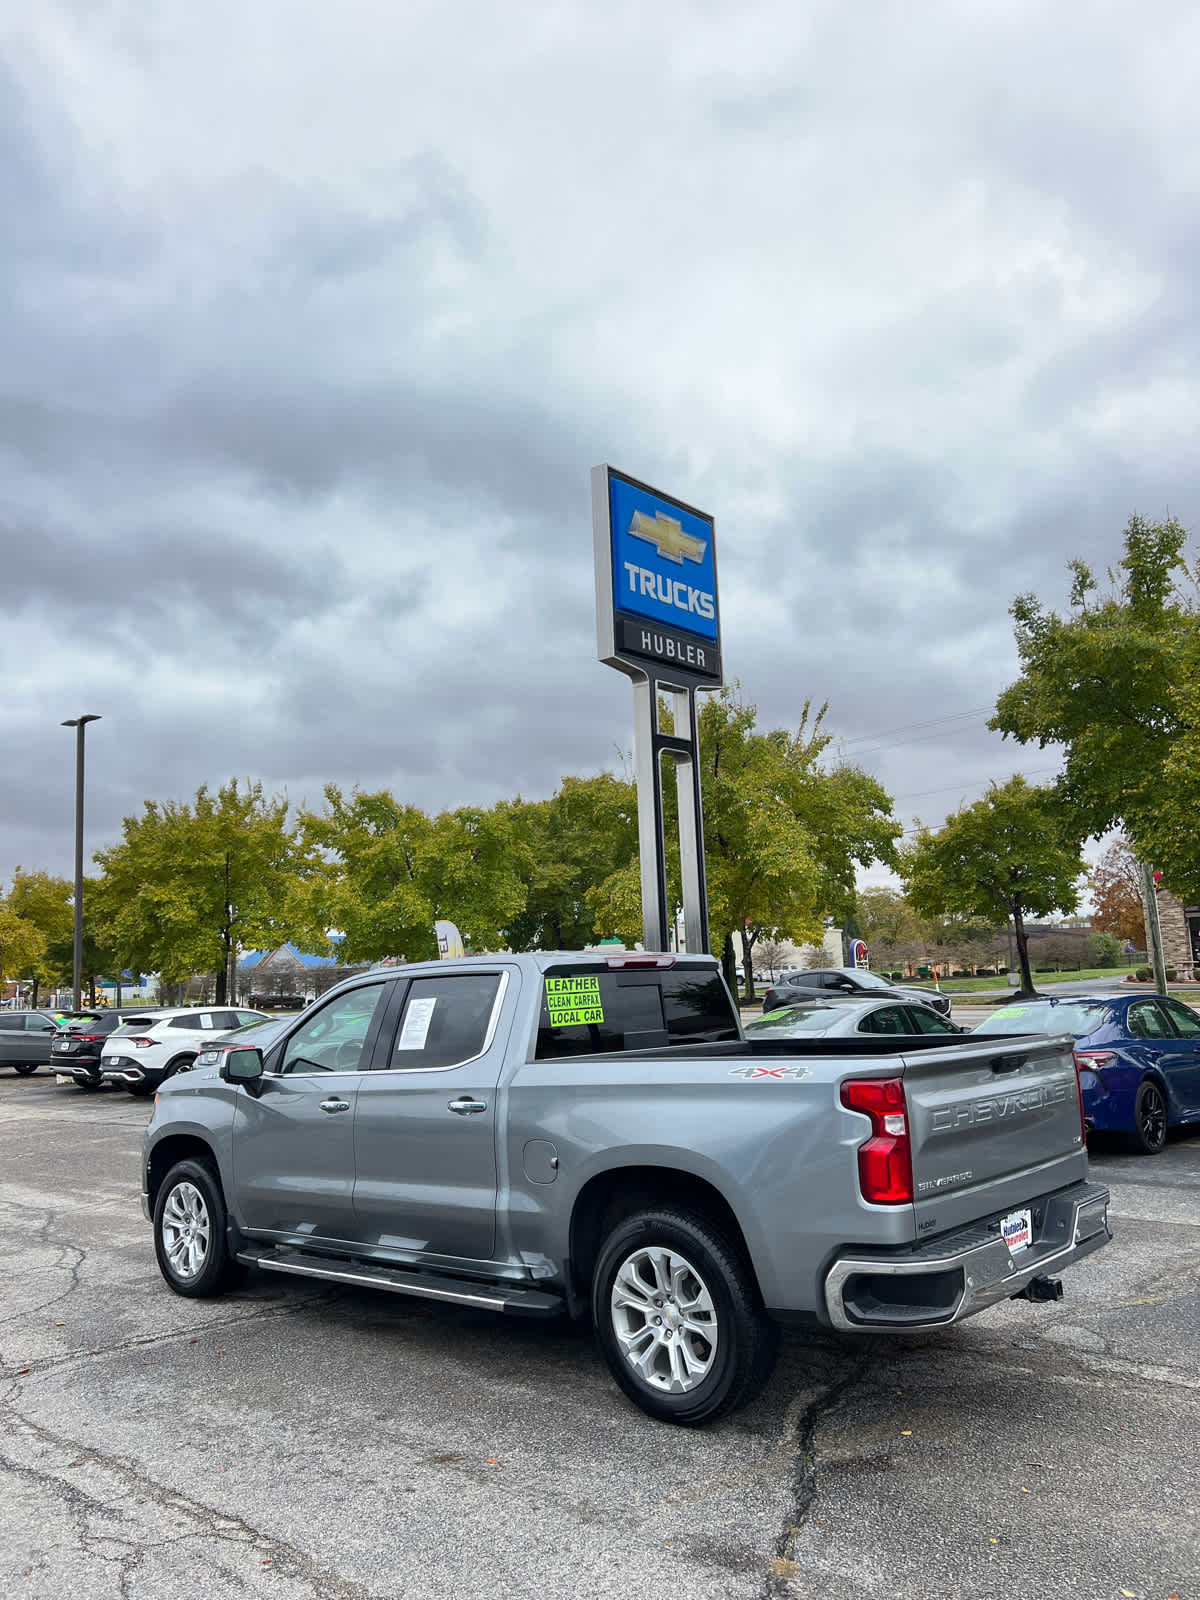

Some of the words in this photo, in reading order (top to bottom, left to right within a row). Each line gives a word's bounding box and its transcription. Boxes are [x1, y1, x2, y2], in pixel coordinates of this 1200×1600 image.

[624, 561, 715, 620] TRUCKS
[641, 631, 706, 667] HUBLER
[547, 978, 597, 992] LEATHER
[548, 996, 571, 1008] CLEAN
[574, 994, 600, 1006] CARFAX
[552, 1011, 581, 1024] LOCAL
[584, 1010, 602, 1021] CAR
[931, 1080, 1077, 1131] CHEVROLET
